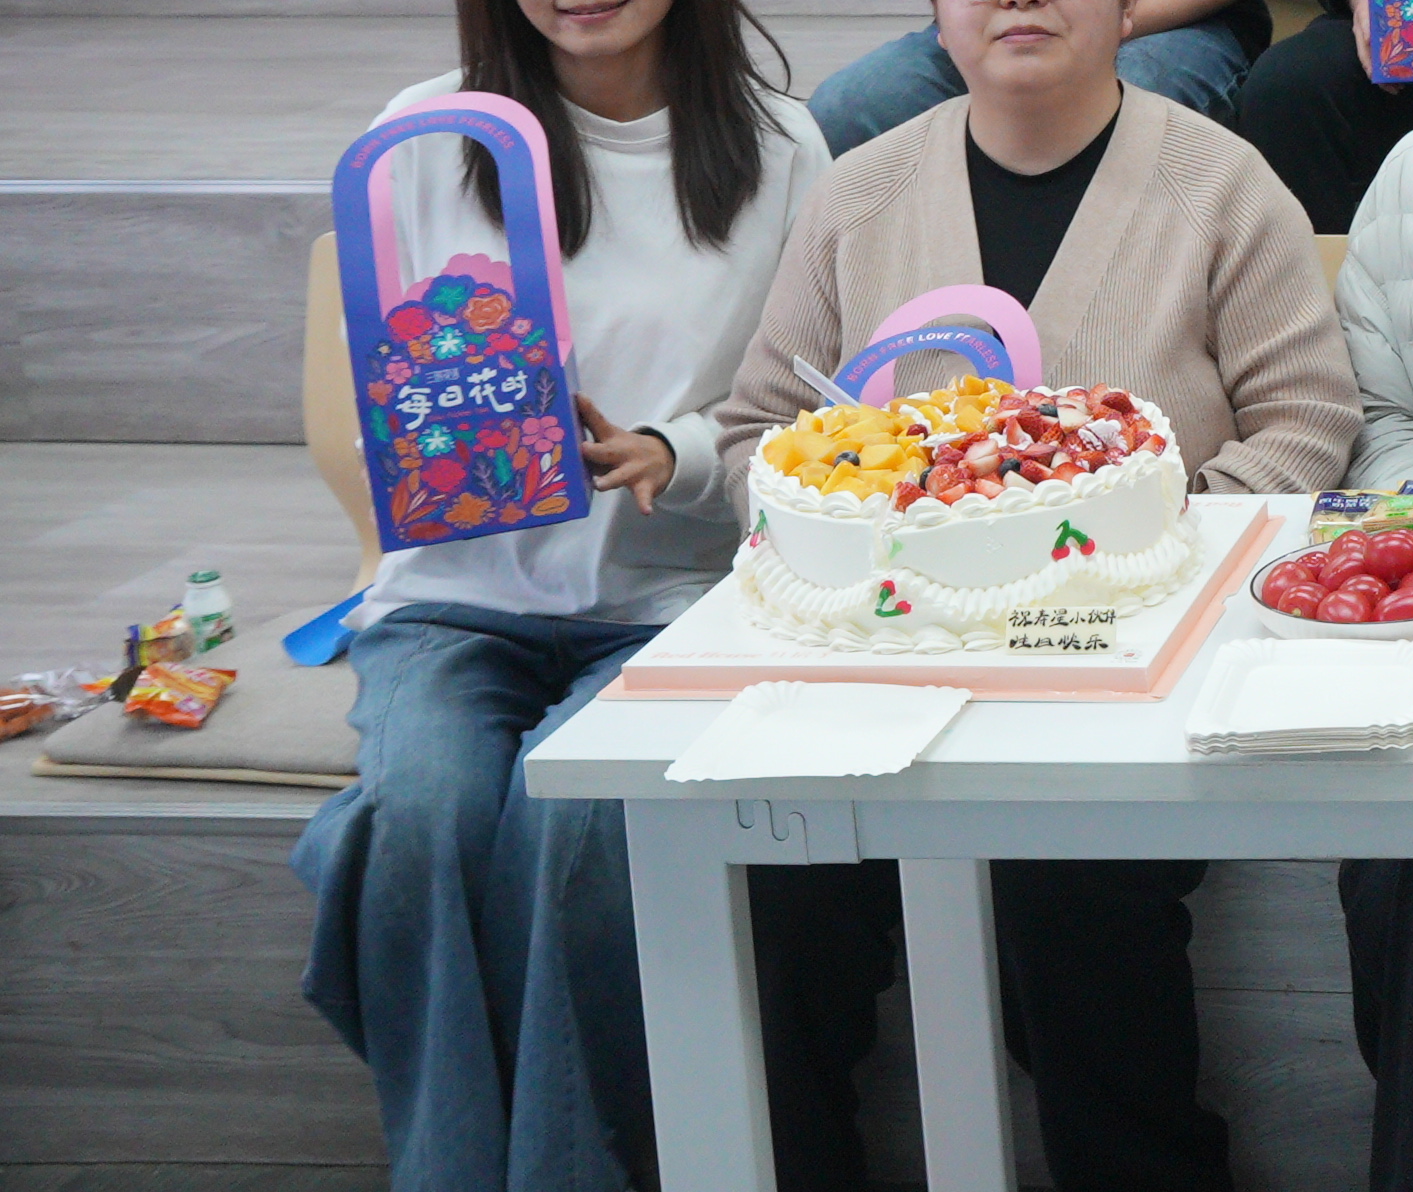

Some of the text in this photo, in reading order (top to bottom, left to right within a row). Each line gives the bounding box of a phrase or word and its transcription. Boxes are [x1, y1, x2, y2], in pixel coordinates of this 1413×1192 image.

[846, 332, 1001, 383] BORN FREE LOVE FEARLESS
[395, 367, 529, 431] 每日花时
